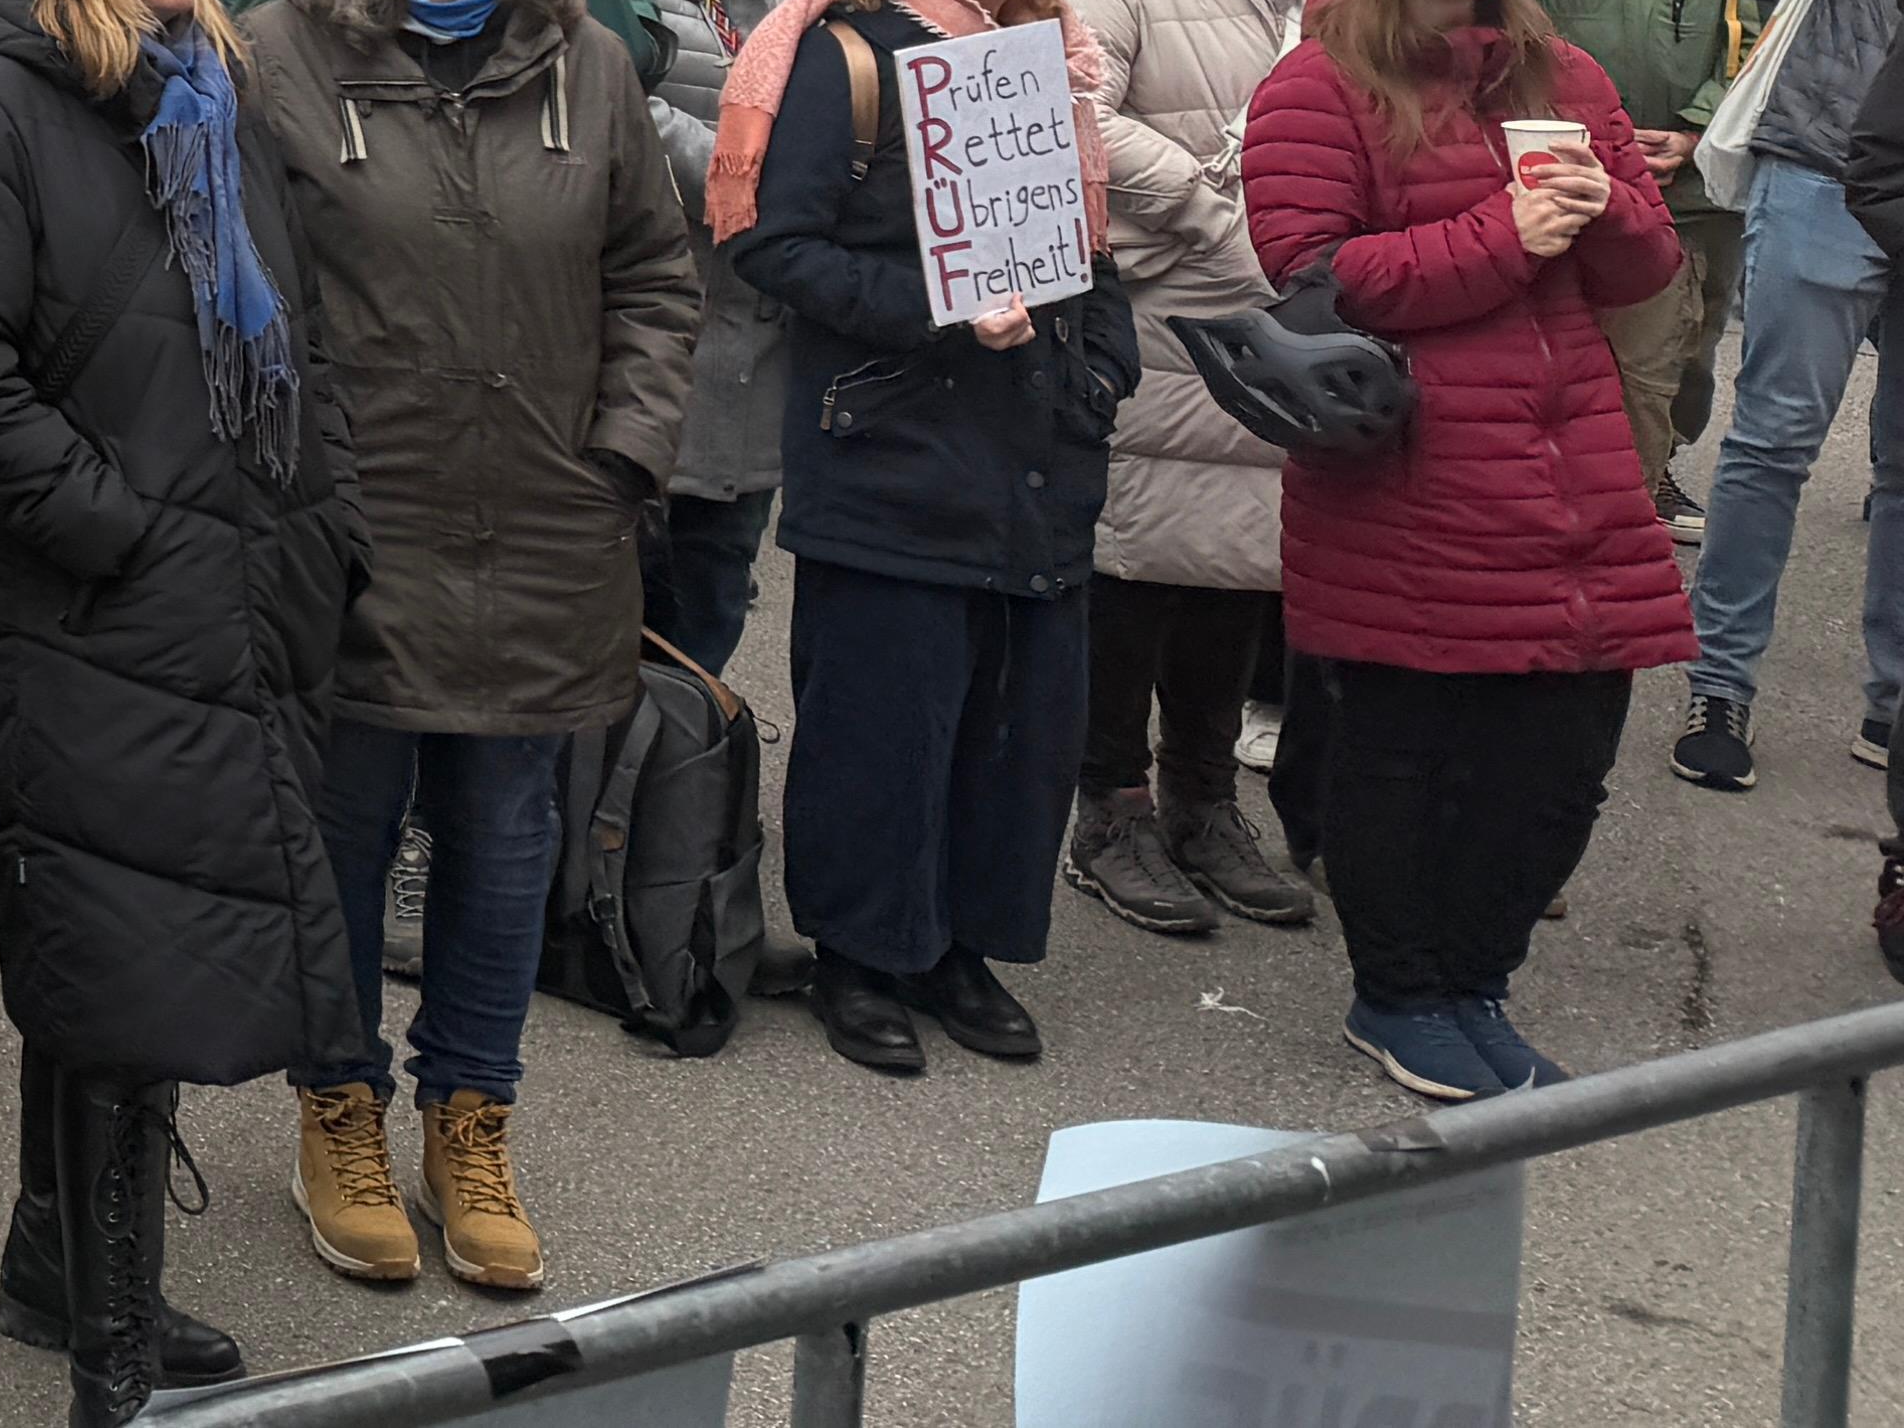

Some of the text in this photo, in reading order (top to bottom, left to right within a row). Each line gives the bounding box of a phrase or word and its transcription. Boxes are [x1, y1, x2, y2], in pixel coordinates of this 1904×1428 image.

[906, 49, 1040, 119] Prüfen
[916, 107, 1071, 180] Rettet
[924, 176, 1079, 239] Übrigens
[929, 217, 1089, 312] Freiheit!
